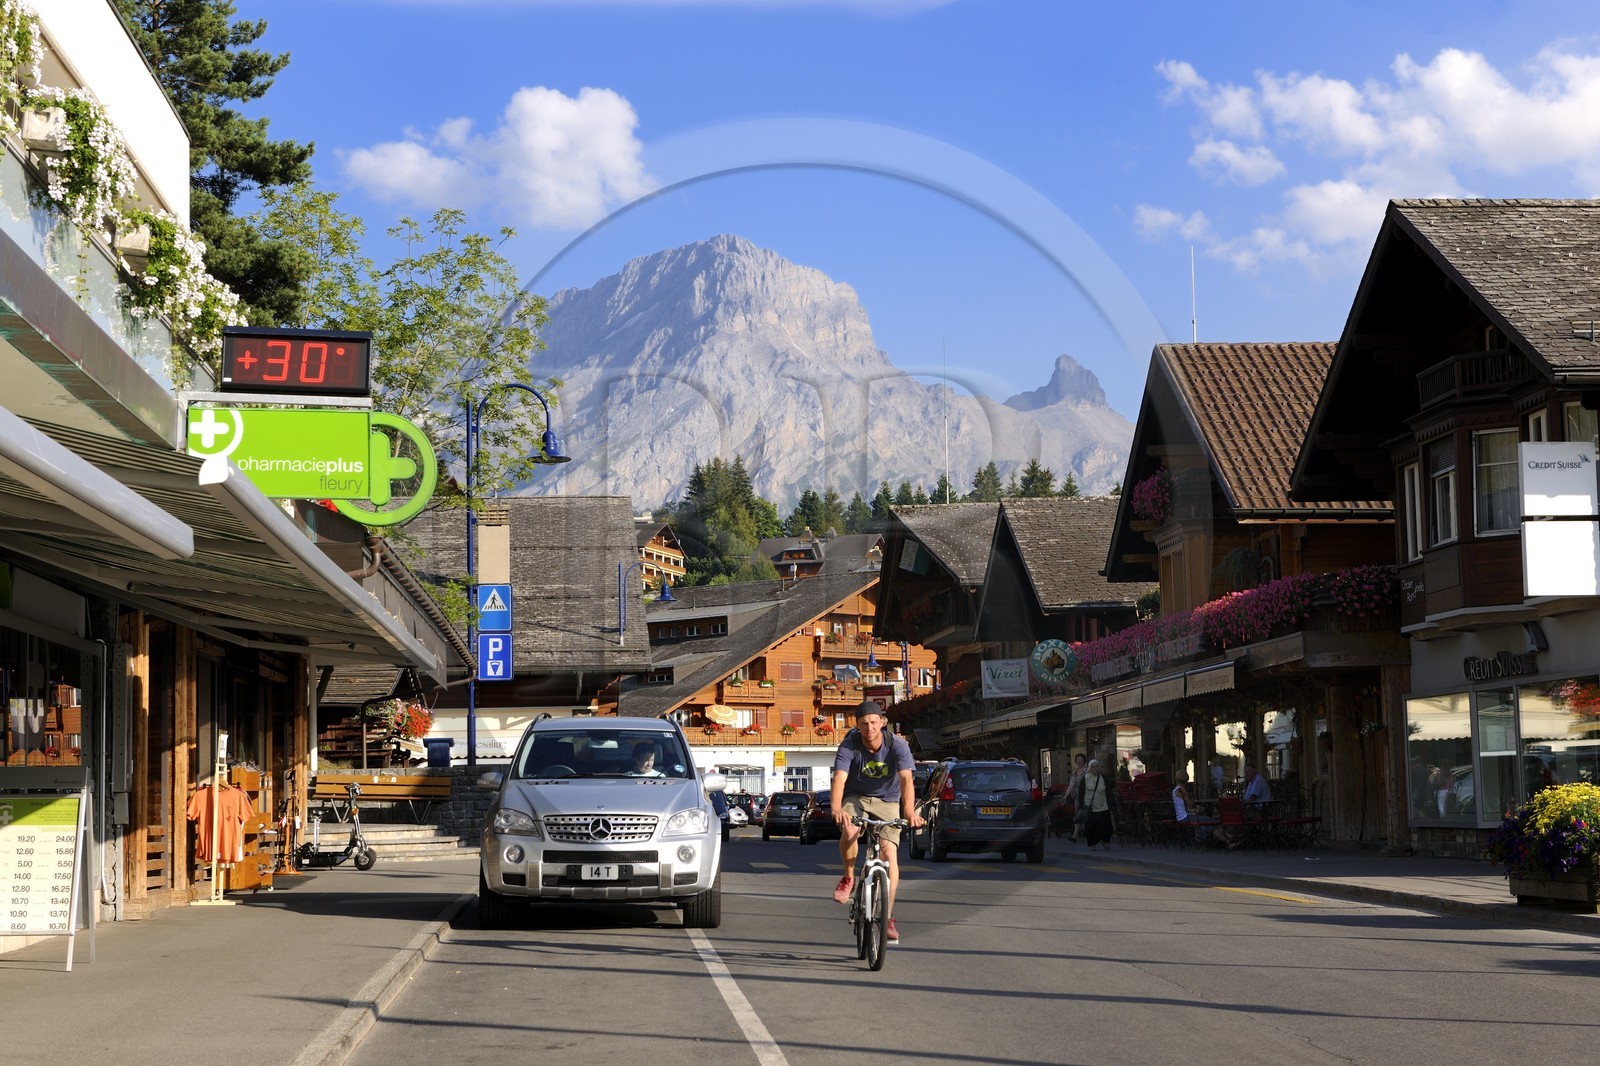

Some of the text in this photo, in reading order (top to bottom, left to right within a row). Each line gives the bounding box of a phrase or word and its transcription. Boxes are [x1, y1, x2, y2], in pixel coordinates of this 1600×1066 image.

[1528, 460, 1583, 469] CREDIT SUISSE
[318, 475, 364, 493] fleury
[489, 637, 503, 660] P
[1033, 639, 1073, 661] BOXER
[987, 665, 1026, 680] Viret
[1463, 656, 1494, 681] CREDIT
[605, 866, 611, 878] T
[12, 885, 30, 893] 12.80
[10, 910, 27, 918] 10.90
[11, 923, 26, 931] 8.60
